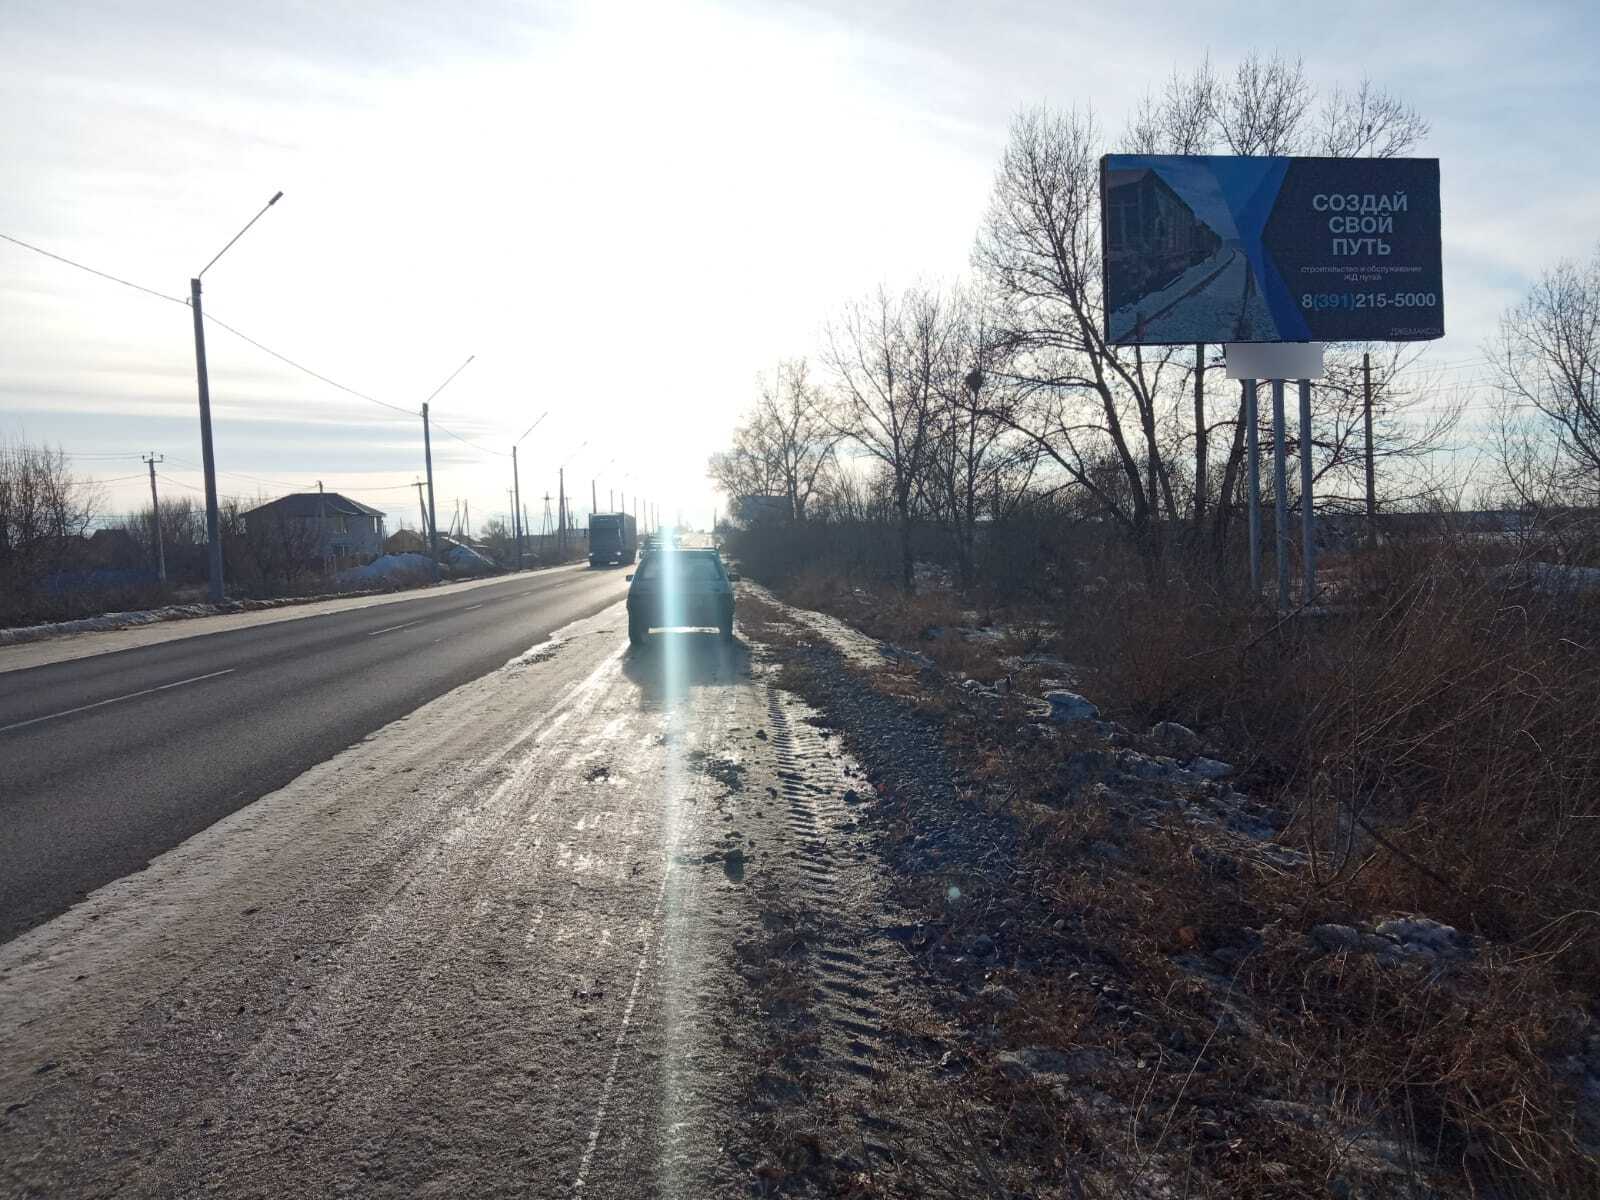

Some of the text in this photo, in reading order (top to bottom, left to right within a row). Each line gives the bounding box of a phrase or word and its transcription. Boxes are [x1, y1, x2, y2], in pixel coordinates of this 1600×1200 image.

[1312, 191, 1409, 215] СОЗДАЙ
[1328, 212, 1393, 234] СВОЙ
[1332, 238, 1391, 256] ПУТЬ
[1301, 292, 1437, 310] 8(391)215-5000
